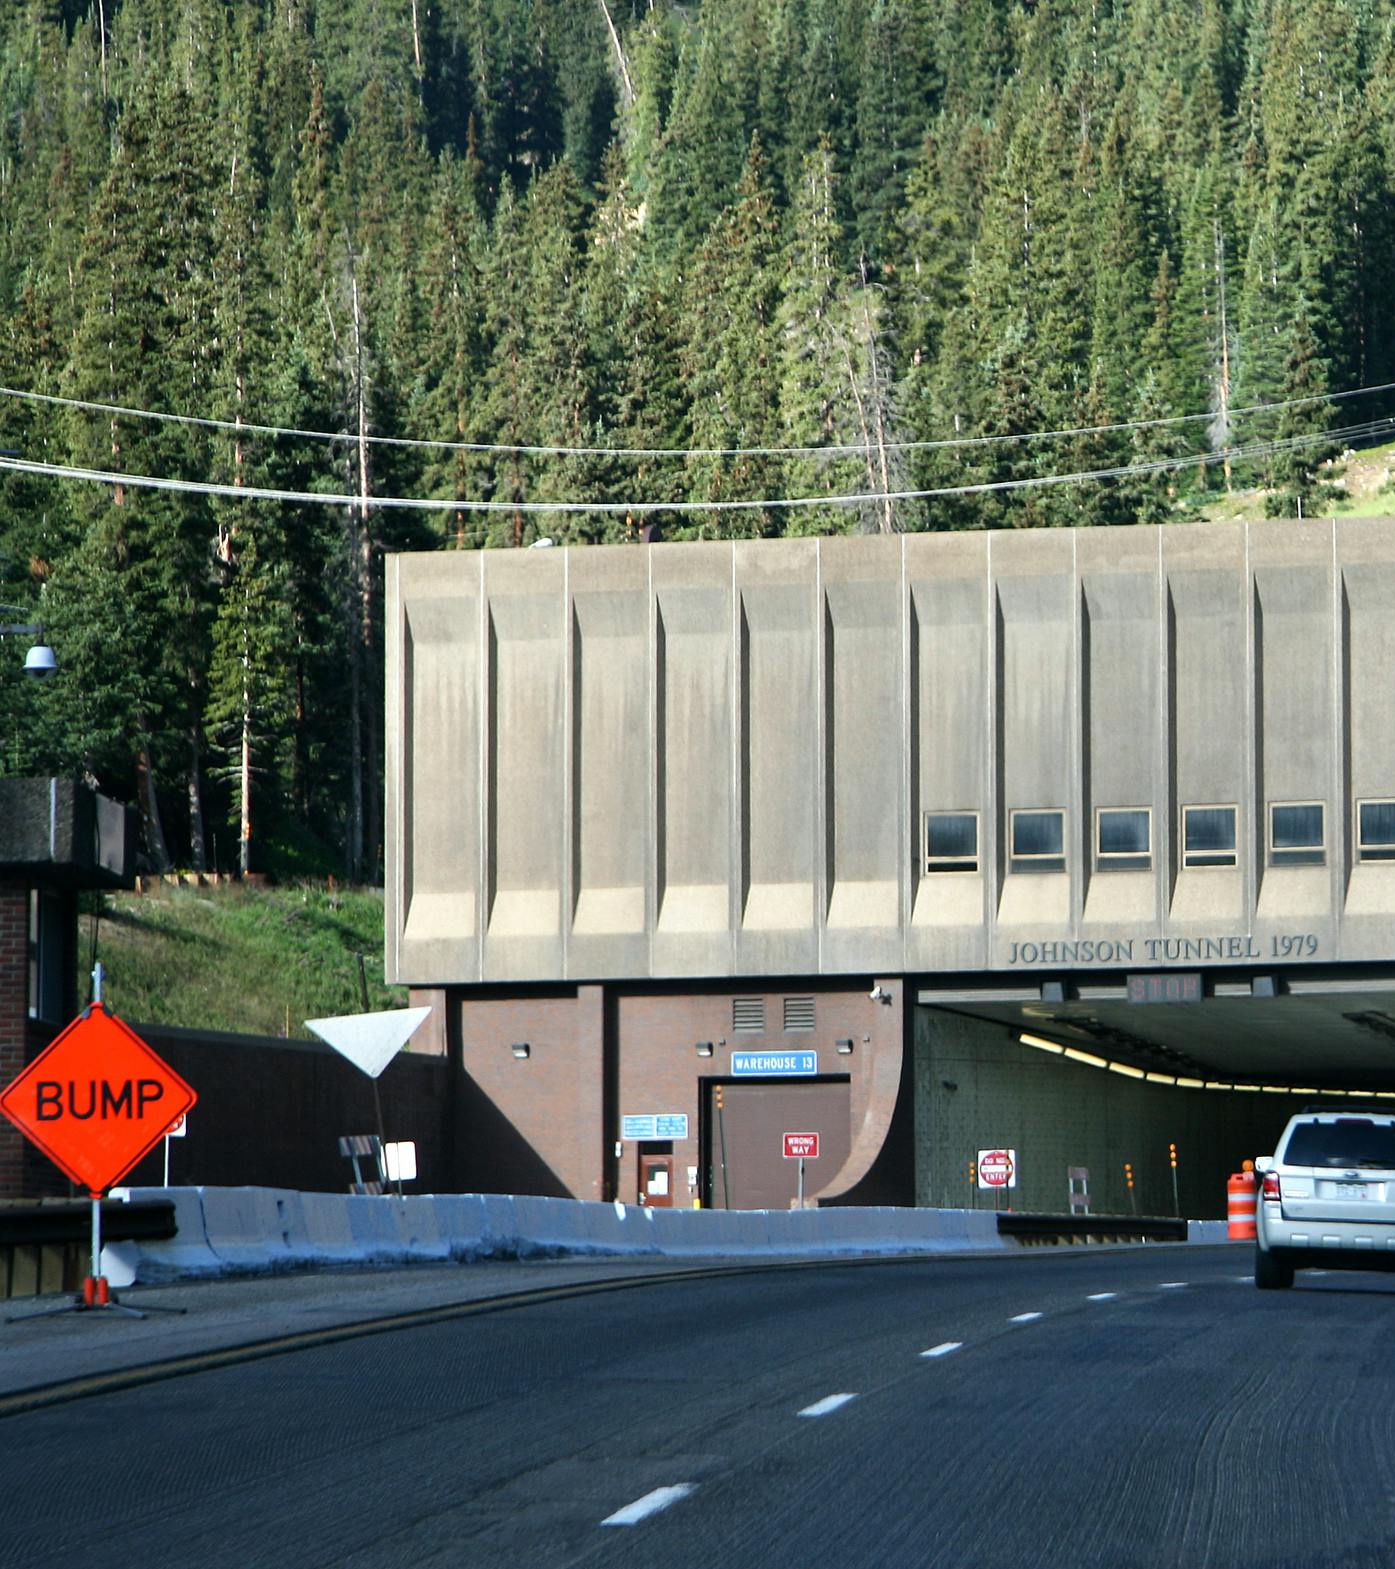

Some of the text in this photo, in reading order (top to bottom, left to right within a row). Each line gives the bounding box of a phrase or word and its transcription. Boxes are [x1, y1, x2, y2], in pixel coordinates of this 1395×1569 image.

[1009, 934, 1319, 964] JOHNSON TUNNEL 1979
[735, 1057, 813, 1069] WAREHOUSE 13
[36, 1079, 164, 1121] BUMP
[787, 1137, 814, 1146] WRONG
[791, 1146, 810, 1154] WAY
[984, 1157, 994, 1165] DO
